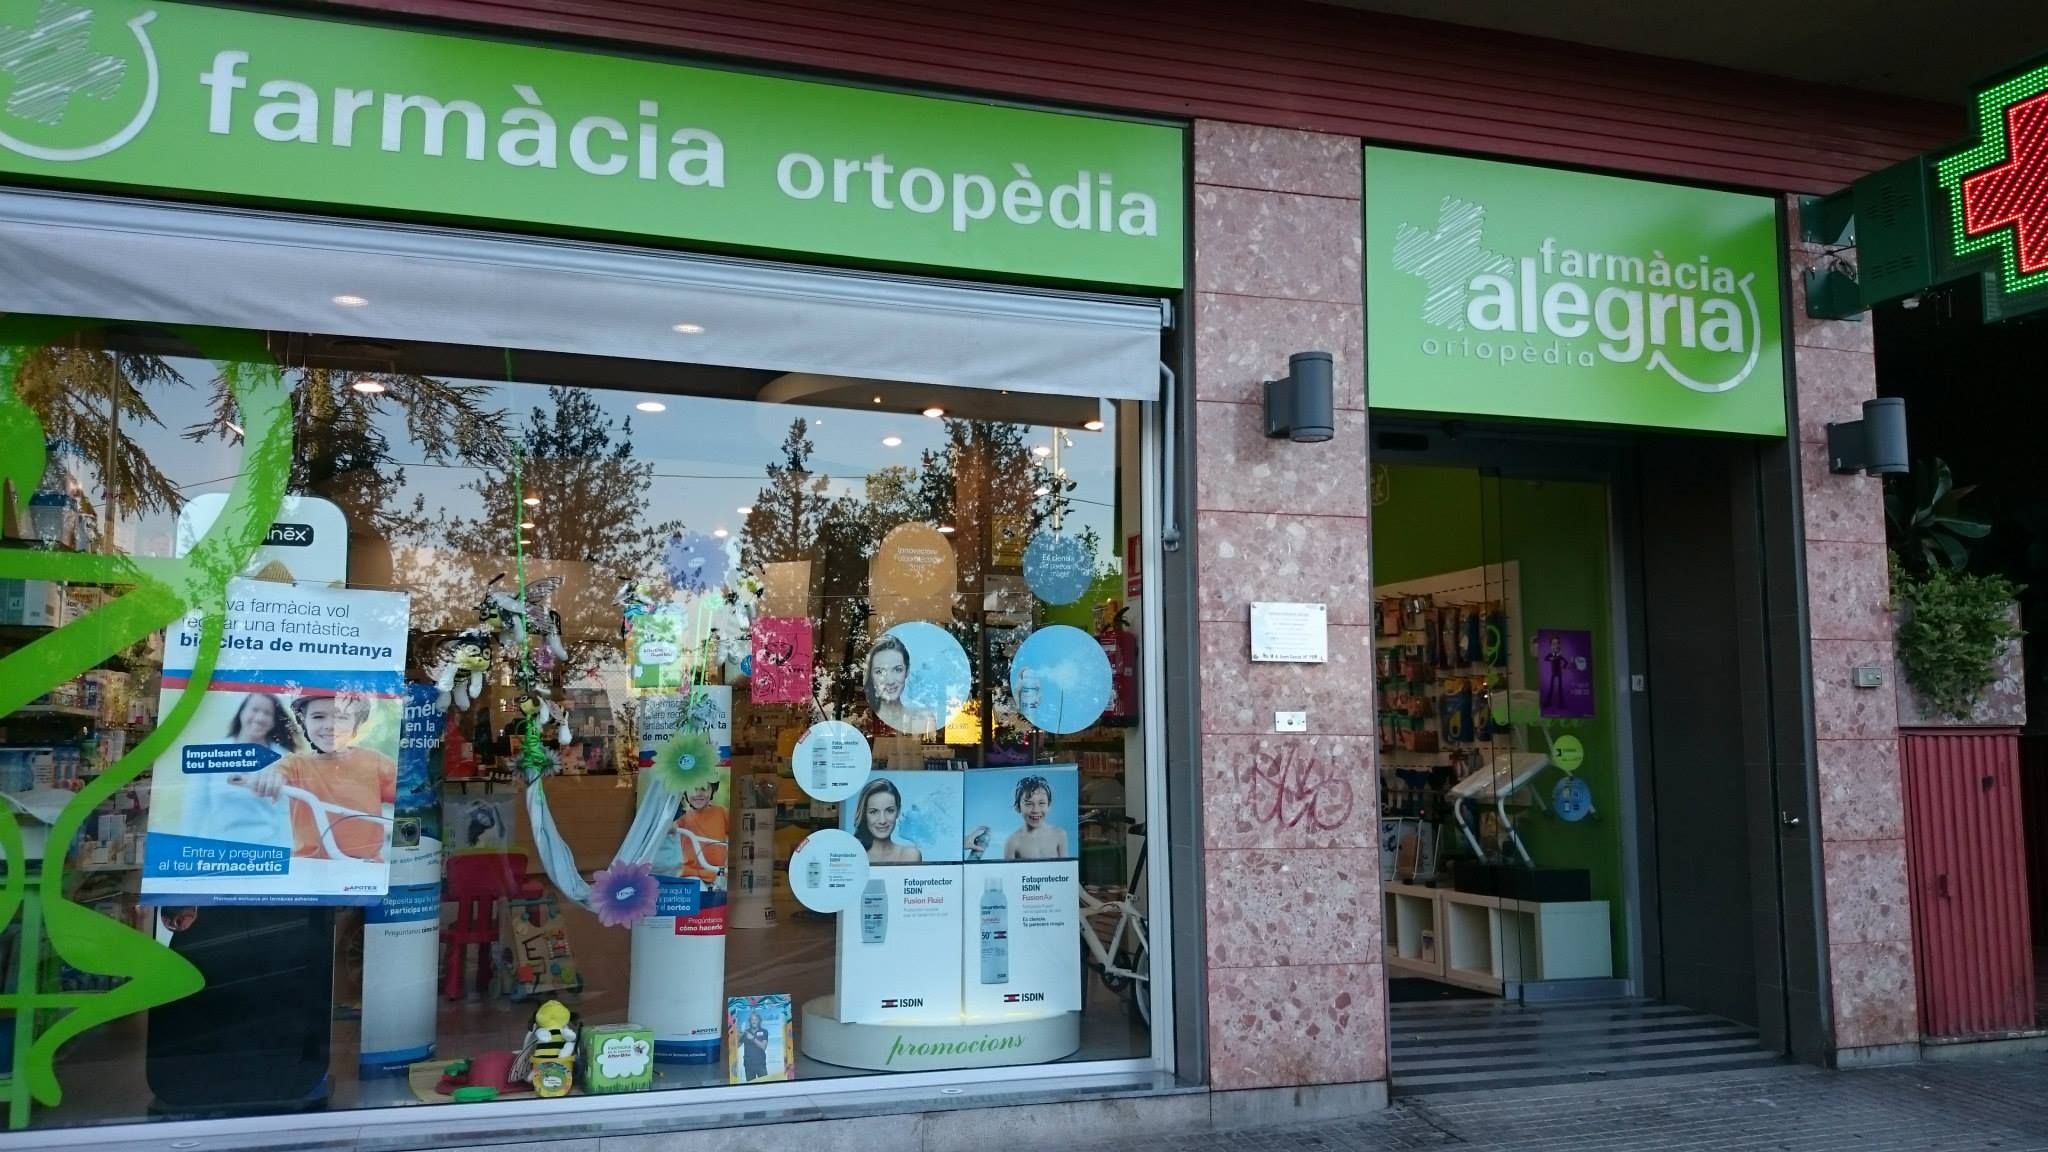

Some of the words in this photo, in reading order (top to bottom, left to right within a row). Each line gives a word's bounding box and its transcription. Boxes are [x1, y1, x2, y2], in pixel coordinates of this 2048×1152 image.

[200, 50, 726, 188] farmàcia
[776, 152, 1158, 237] ortopèdia
[1539, 237, 1736, 295] farmàcia
[1466, 256, 1745, 363] alegria
[1422, 337, 1595, 368] ortopèdia
[250, 598, 321, 617] farmàcia
[326, 604, 350, 618] vol
[244, 619, 276, 633] una
[281, 618, 360, 638] fantàstica
[269, 637, 294, 652] de
[298, 641, 393, 660] muntanya
[405, 722, 421, 731] en
[426, 720, 435, 731] la
[400, 735, 440, 748] ersión
[186, 748, 243, 759] Impulsant
[245, 748, 256, 757] el
[186, 760, 205, 769] teu
[208, 759, 258, 769] benestar
[182, 846, 215, 858] Entra
[218, 848, 226, 860] y
[229, 848, 283, 861] pregunta
[158, 860, 170, 871] al
[173, 860, 193, 871] teu
[197, 859, 282, 872] farmacèutic
[903, 878, 953, 887] Fotoprotector
[1022, 875, 1069, 884] Fotoprotector
[903, 887, 923, 895] ISDIN
[1022, 884, 1041, 892] ISDIN
[903, 896, 925, 904] Fusion
[927, 896, 944, 904] Fluid
[679, 923, 698, 931] cómo
[899, 998, 924, 1008] ISDIN
[1021, 992, 1045, 1002] ISDIN
[885, 1033, 1025, 1066] promocions
